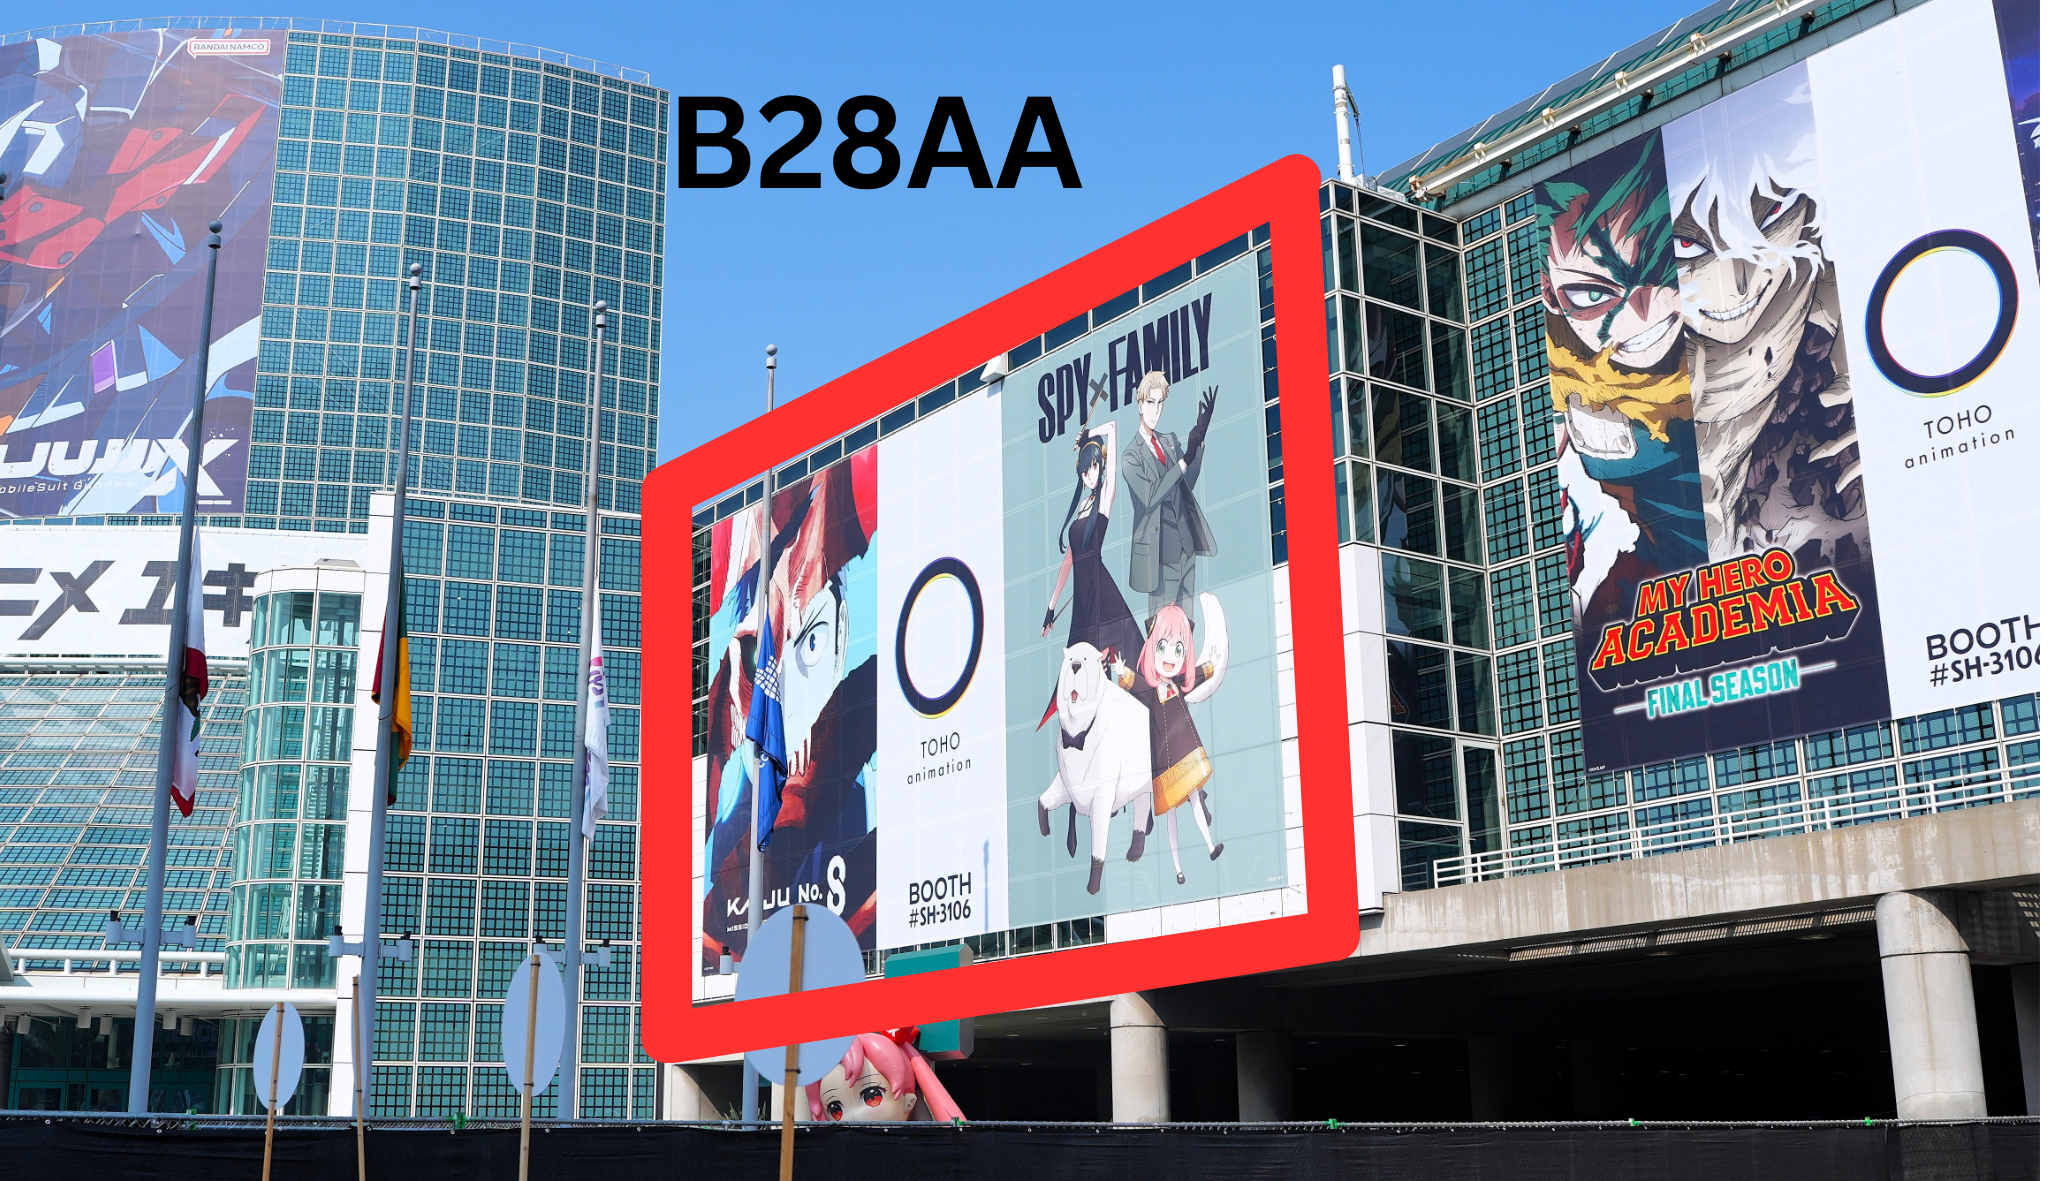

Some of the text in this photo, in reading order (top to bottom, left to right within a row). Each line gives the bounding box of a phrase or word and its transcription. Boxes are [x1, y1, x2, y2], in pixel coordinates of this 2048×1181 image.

[193, 43, 265, 51] BANDAI NAMCO
[1923, 404, 1992, 439] TOHO
[1904, 429, 2015, 469] animation
[1637, 549, 1794, 617] MY HERO
[1591, 572, 1858, 670] ACADEMIA
[1926, 614, 2040, 661] BOOTH
[1646, 658, 1800, 717] FINAL SEASON
[920, 731, 961, 759] TOHO
[907, 758, 972, 785] animation
[726, 887, 790, 918] KAJU
[909, 871, 972, 905] BOOTH
[908, 898, 972, 929] #SH-3106
